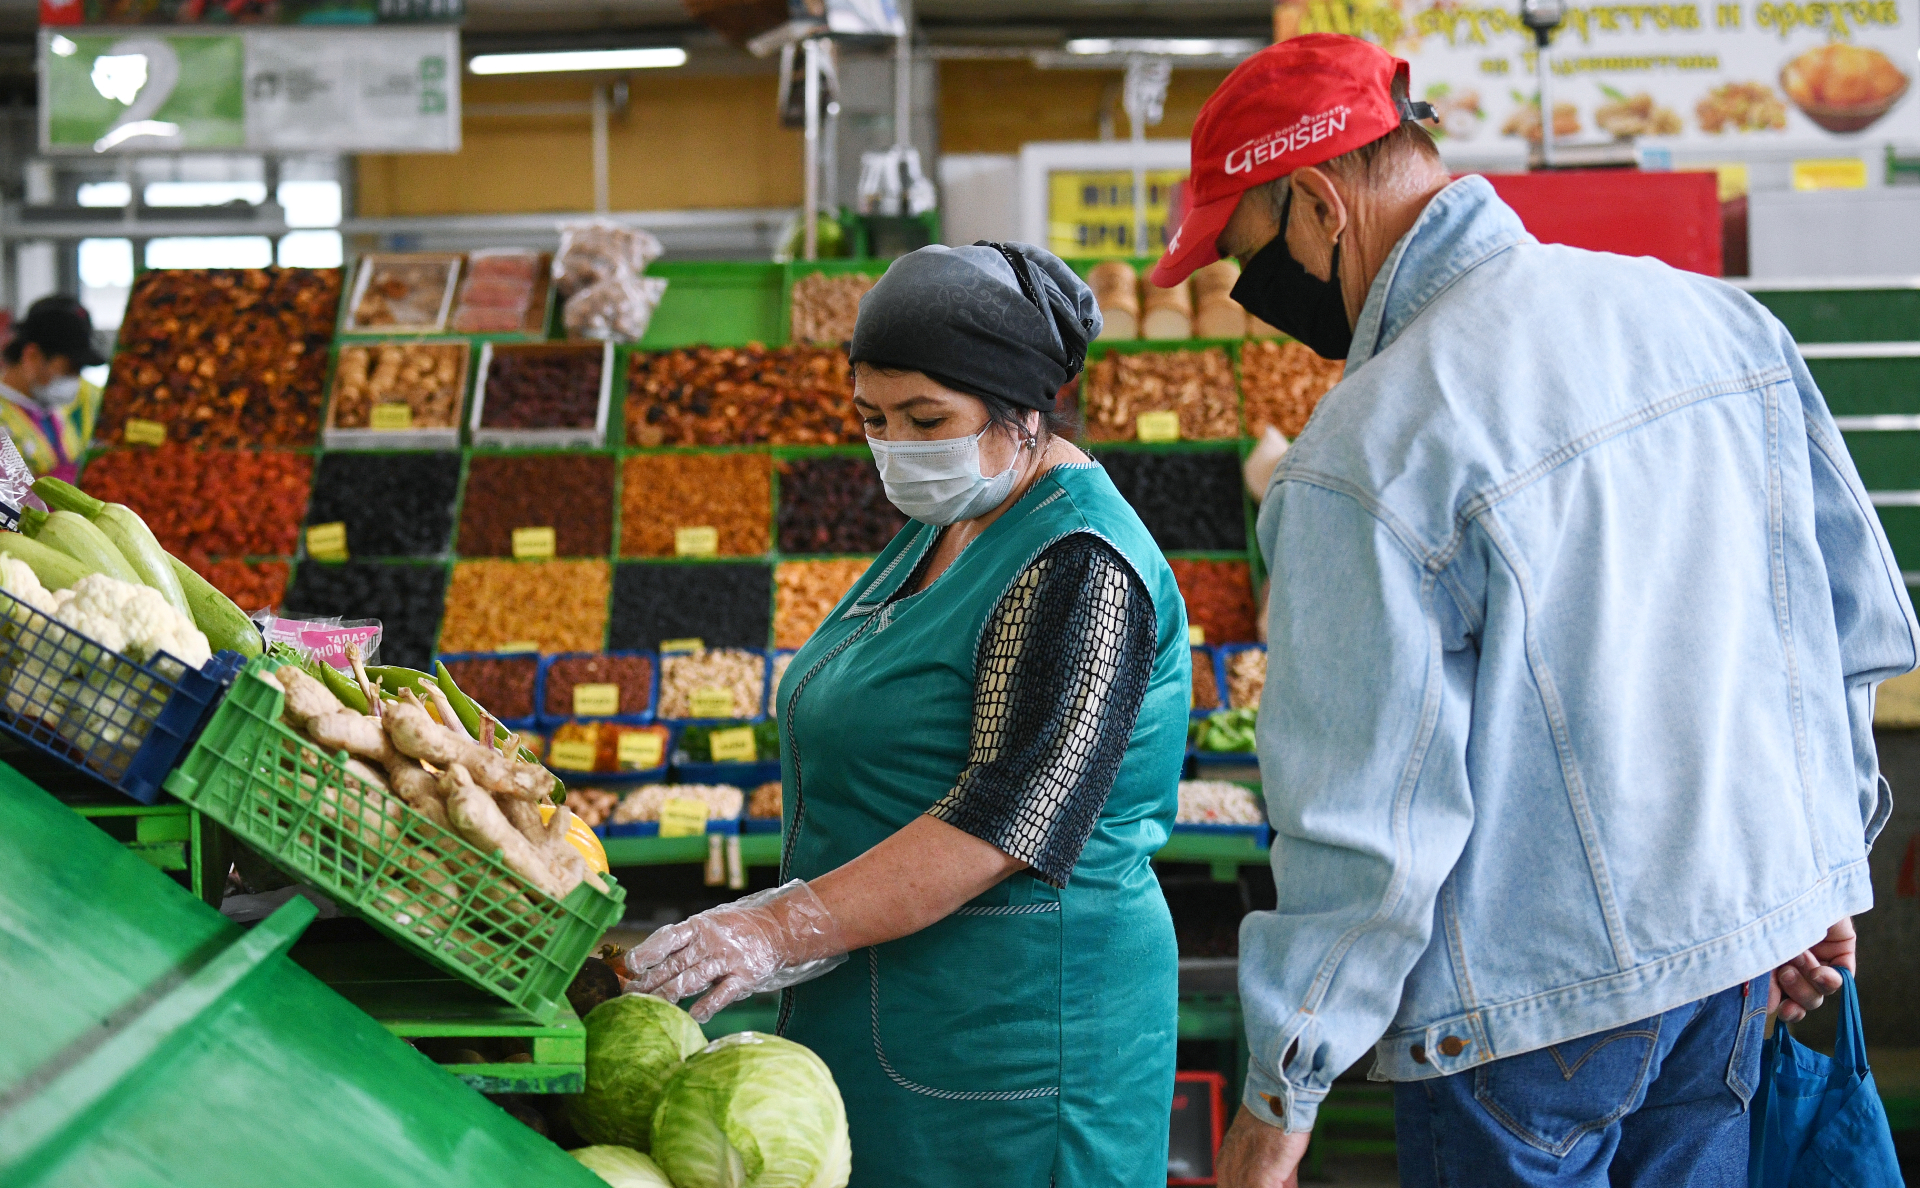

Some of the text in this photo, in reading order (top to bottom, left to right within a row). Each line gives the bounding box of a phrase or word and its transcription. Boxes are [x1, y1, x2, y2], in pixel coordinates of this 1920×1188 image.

[1413, 6, 1700, 46] сухоуктов
[1717, 4, 1740, 28] и
[1756, 1, 1899, 38] орехов
[1225, 112, 1346, 175] GEDISEN
[1275, 122, 1300, 138] DOOR
[1311, 105, 1344, 123] SPORTS
